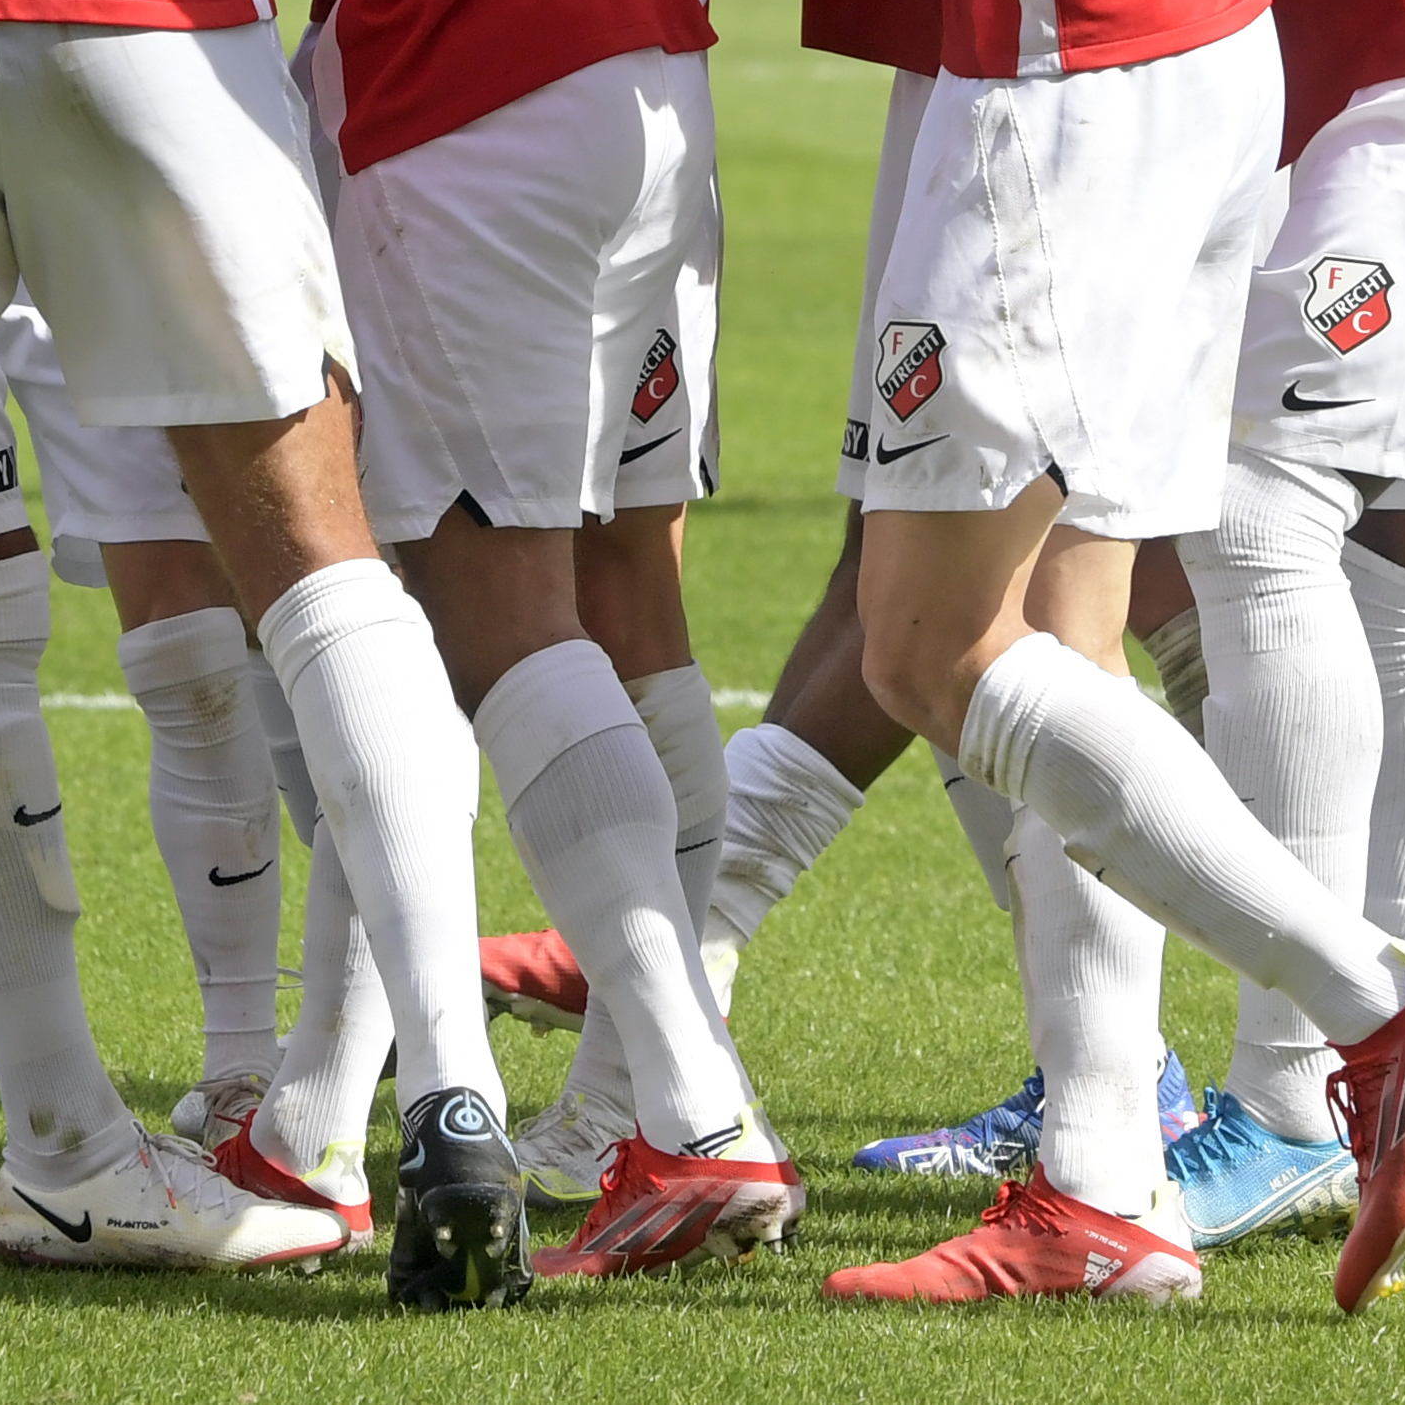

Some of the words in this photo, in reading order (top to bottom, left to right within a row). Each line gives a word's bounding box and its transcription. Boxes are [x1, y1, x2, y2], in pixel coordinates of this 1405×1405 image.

[1313, 269, 1388, 332] UTRECHT
[881, 330, 940, 399] UTRECHT
[107, 1218, 159, 1229] PHANTOM
